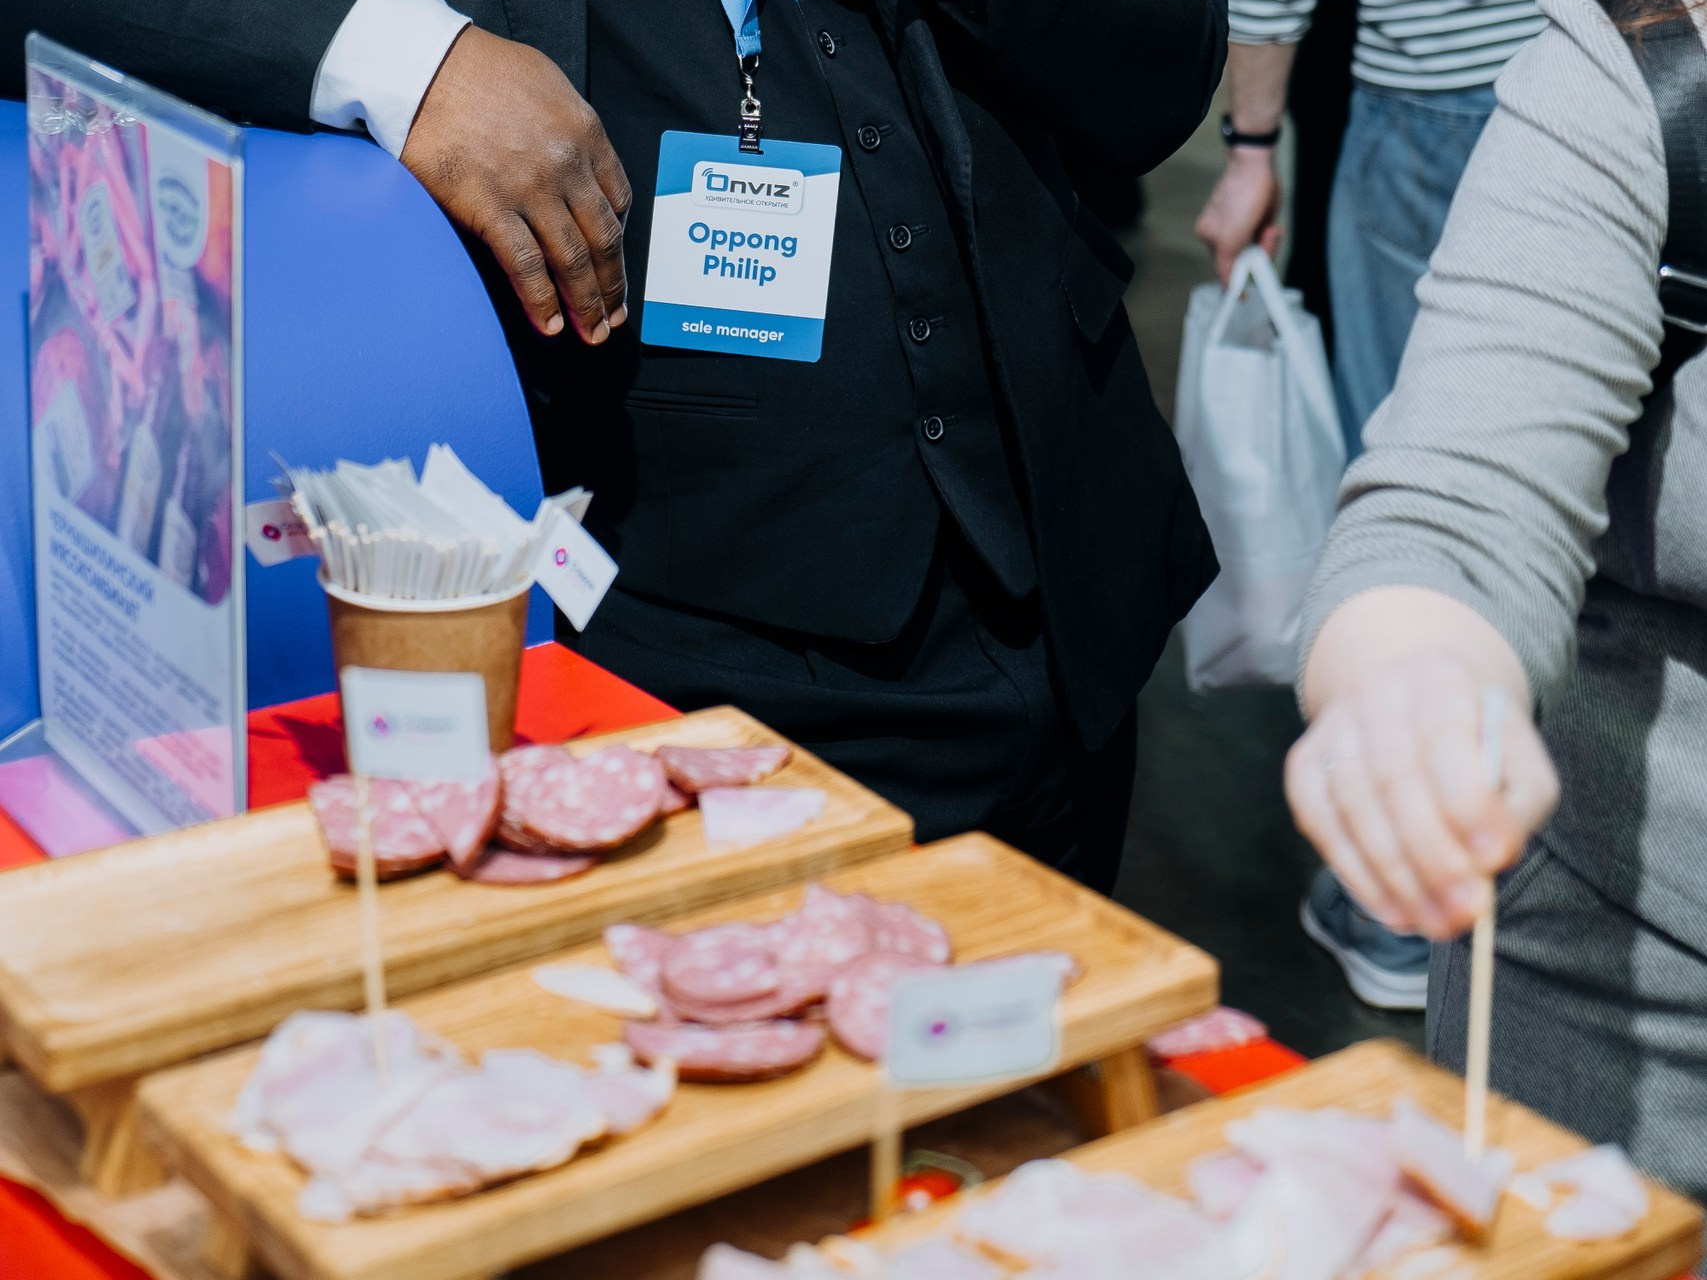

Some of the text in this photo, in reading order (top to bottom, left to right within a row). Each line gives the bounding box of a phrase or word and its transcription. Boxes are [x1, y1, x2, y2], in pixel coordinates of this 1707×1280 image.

[705, 195, 789, 209] УДИВИТЕЛЬНОЕ ОТКРЫТИЕ
[688, 222, 798, 258] Oppong
[703, 254, 777, 286] Philip
[682, 320, 784, 343] sale manager
